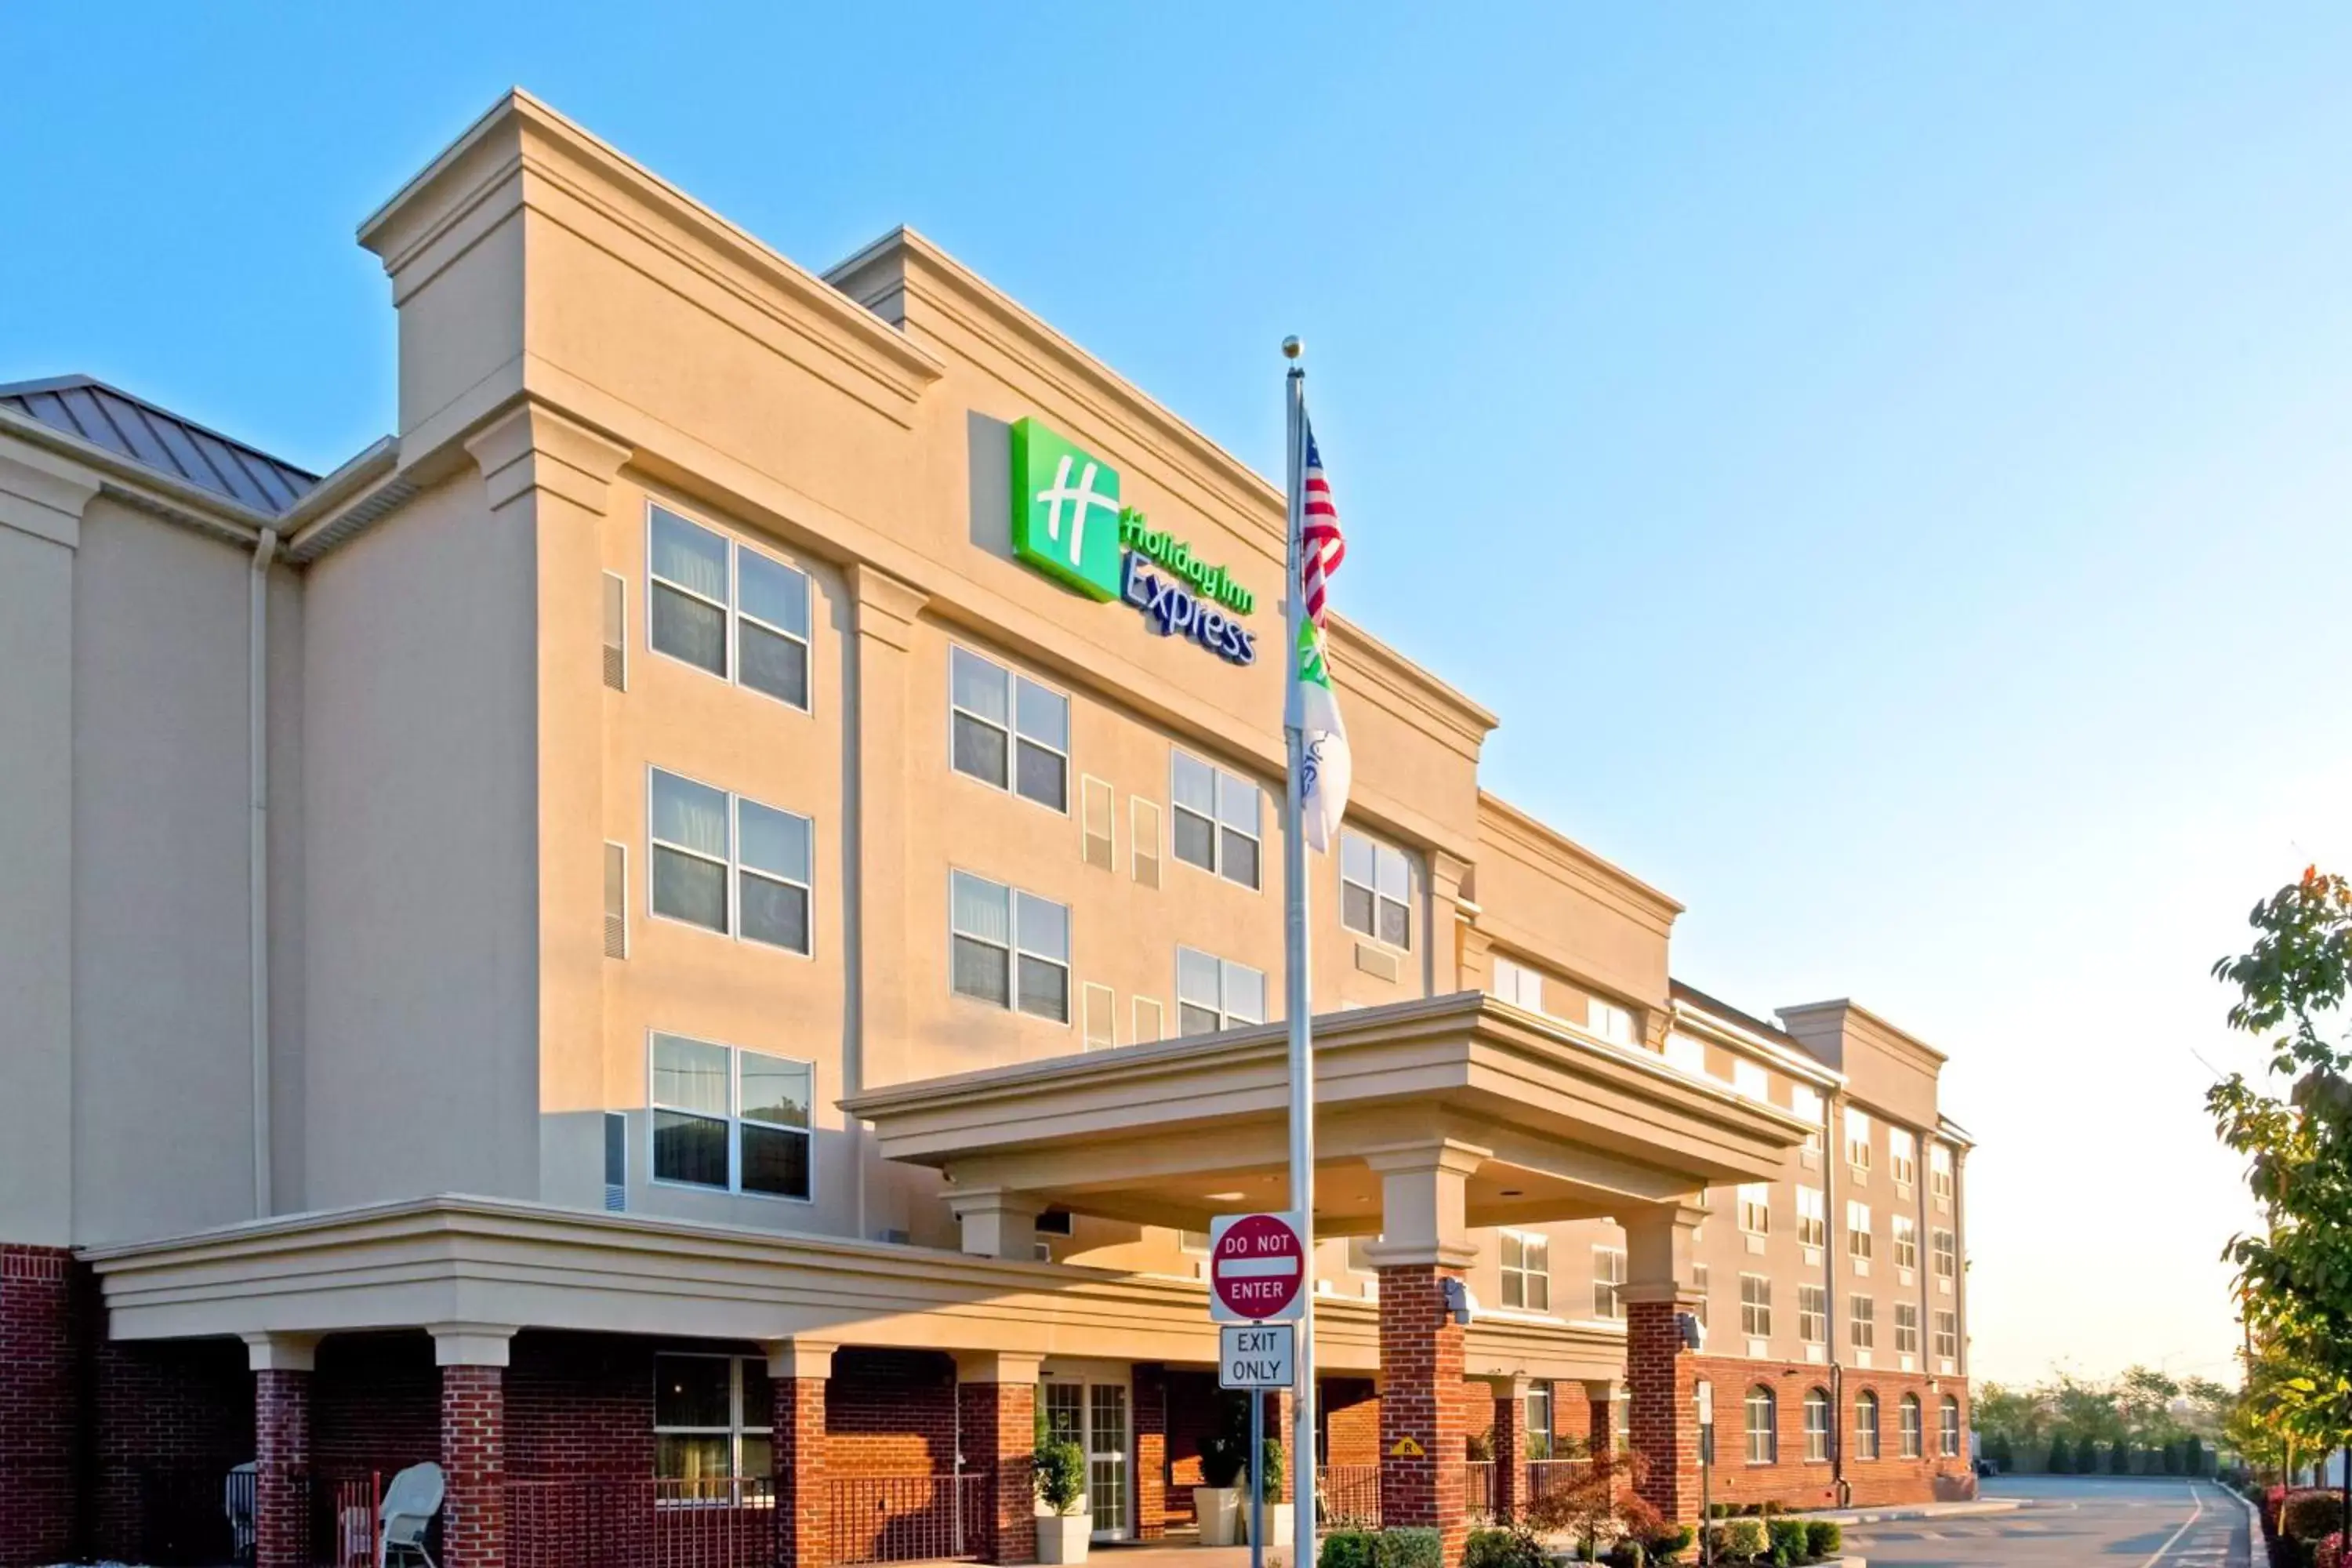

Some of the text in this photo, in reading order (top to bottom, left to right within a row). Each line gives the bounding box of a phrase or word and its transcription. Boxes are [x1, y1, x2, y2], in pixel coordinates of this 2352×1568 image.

[1036, 454, 1119, 567] H
[1124, 550, 1257, 664] Express
[1225, 1234, 1290, 1254] DO NOT
[1232, 1282, 1283, 1299] ENTER
[1238, 1333, 1277, 1352] EXIT
[1233, 1361, 1281, 1380] ONLY
